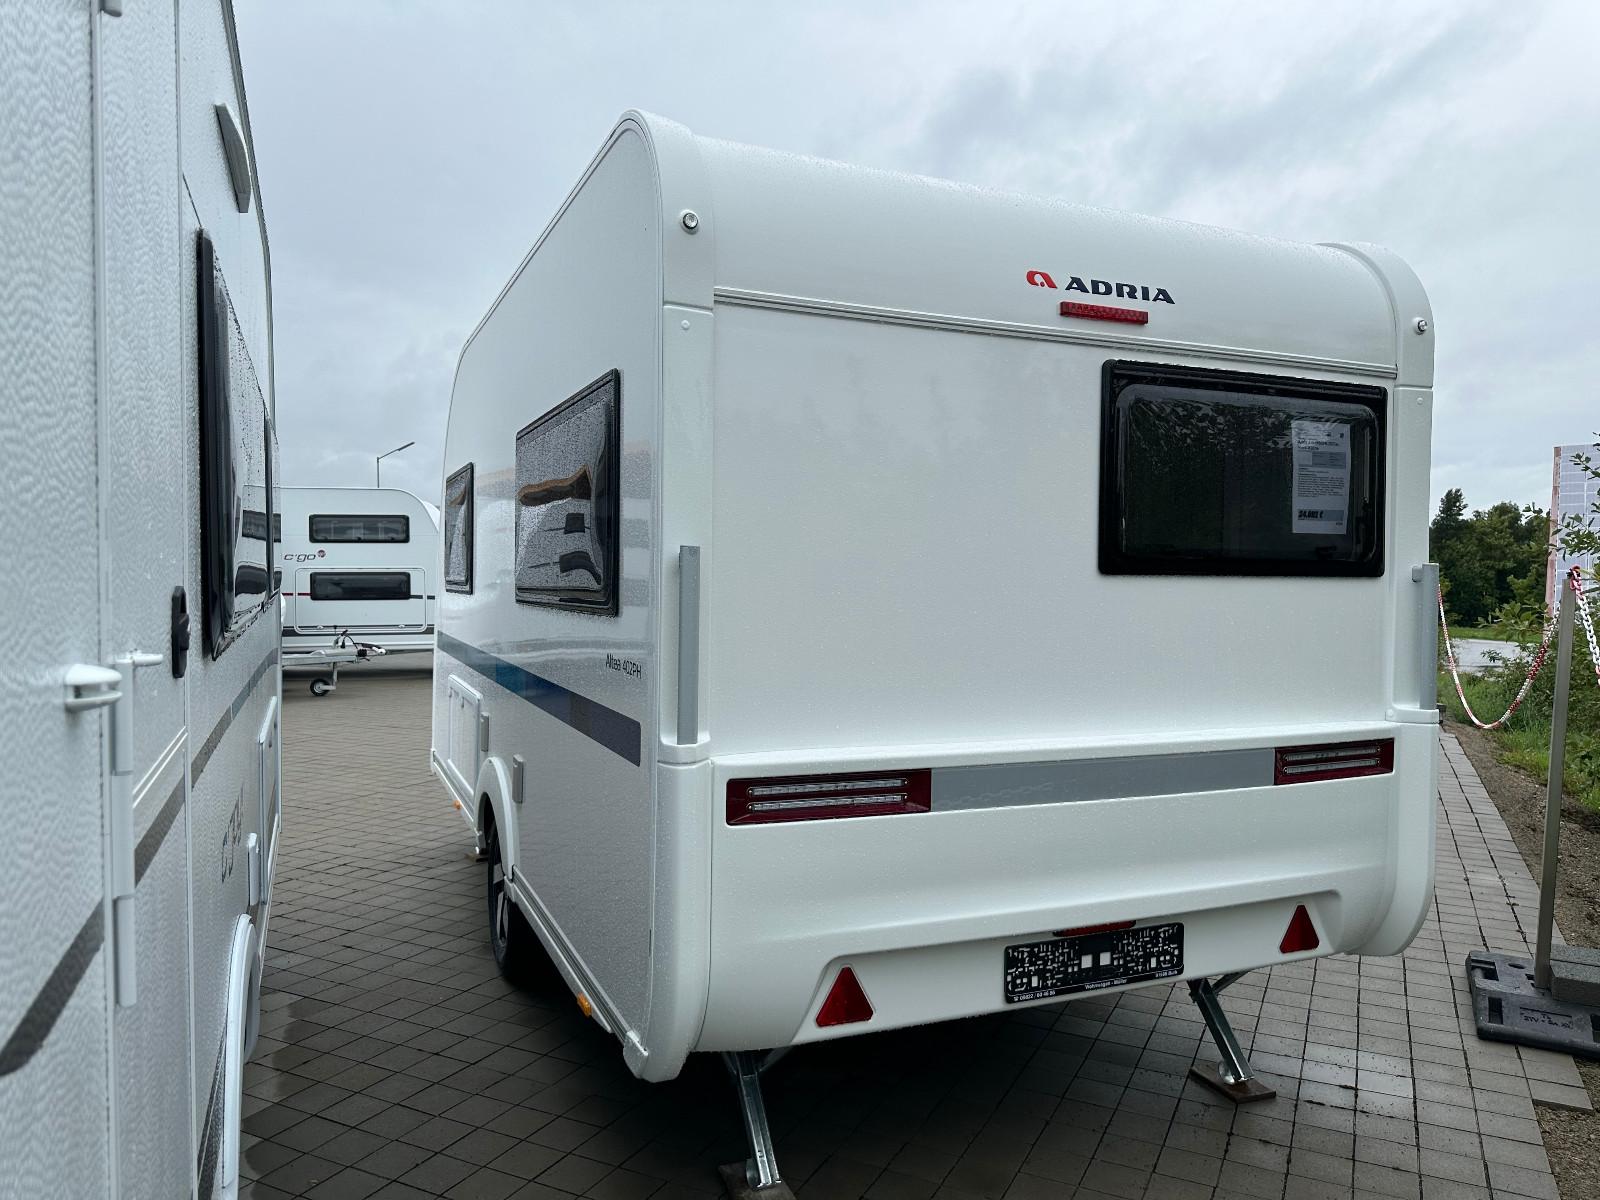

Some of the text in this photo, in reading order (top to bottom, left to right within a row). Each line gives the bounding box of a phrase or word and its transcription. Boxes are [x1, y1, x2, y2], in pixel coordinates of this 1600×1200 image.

[1064, 275, 1176, 304] ADRIA
[283, 553, 316, 563] c'go
[622, 659, 642, 680] 402PH
